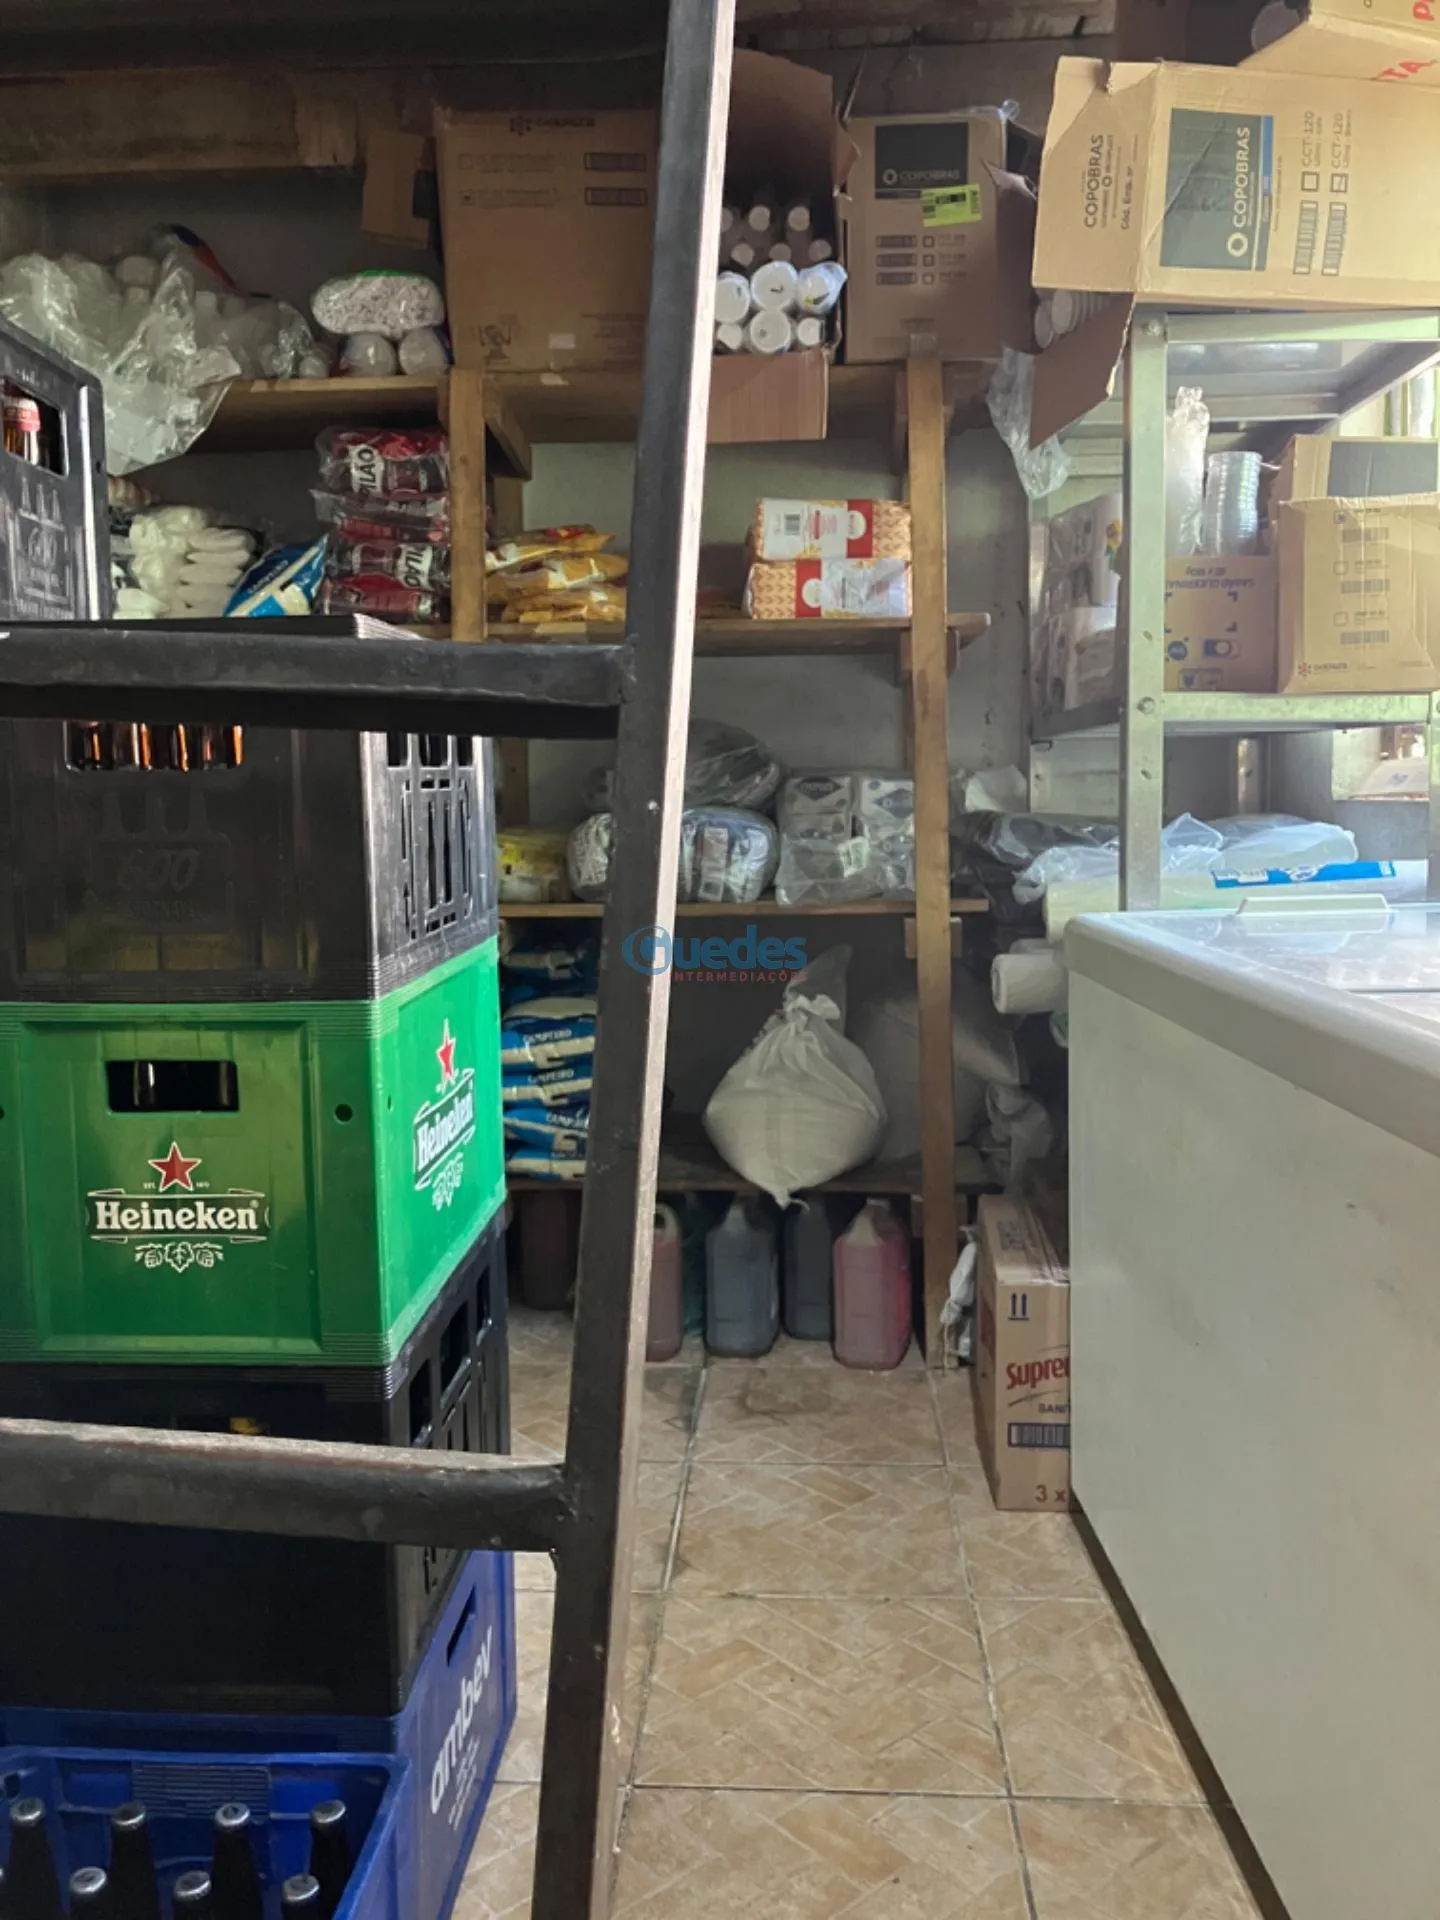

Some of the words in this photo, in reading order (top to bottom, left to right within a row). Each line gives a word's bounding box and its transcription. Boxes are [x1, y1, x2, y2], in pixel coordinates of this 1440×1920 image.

[1083, 134, 1104, 228] COPOBRAS
[1233, 126, 1251, 228] COPOBRAS
[416, 1091, 474, 1172] Heineken
[95, 1201, 258, 1230] Heineken
[1035, 1485, 1049, 1503] 3
[1054, 1490, 1067, 1503] x
[430, 1625, 493, 1814] ambev
